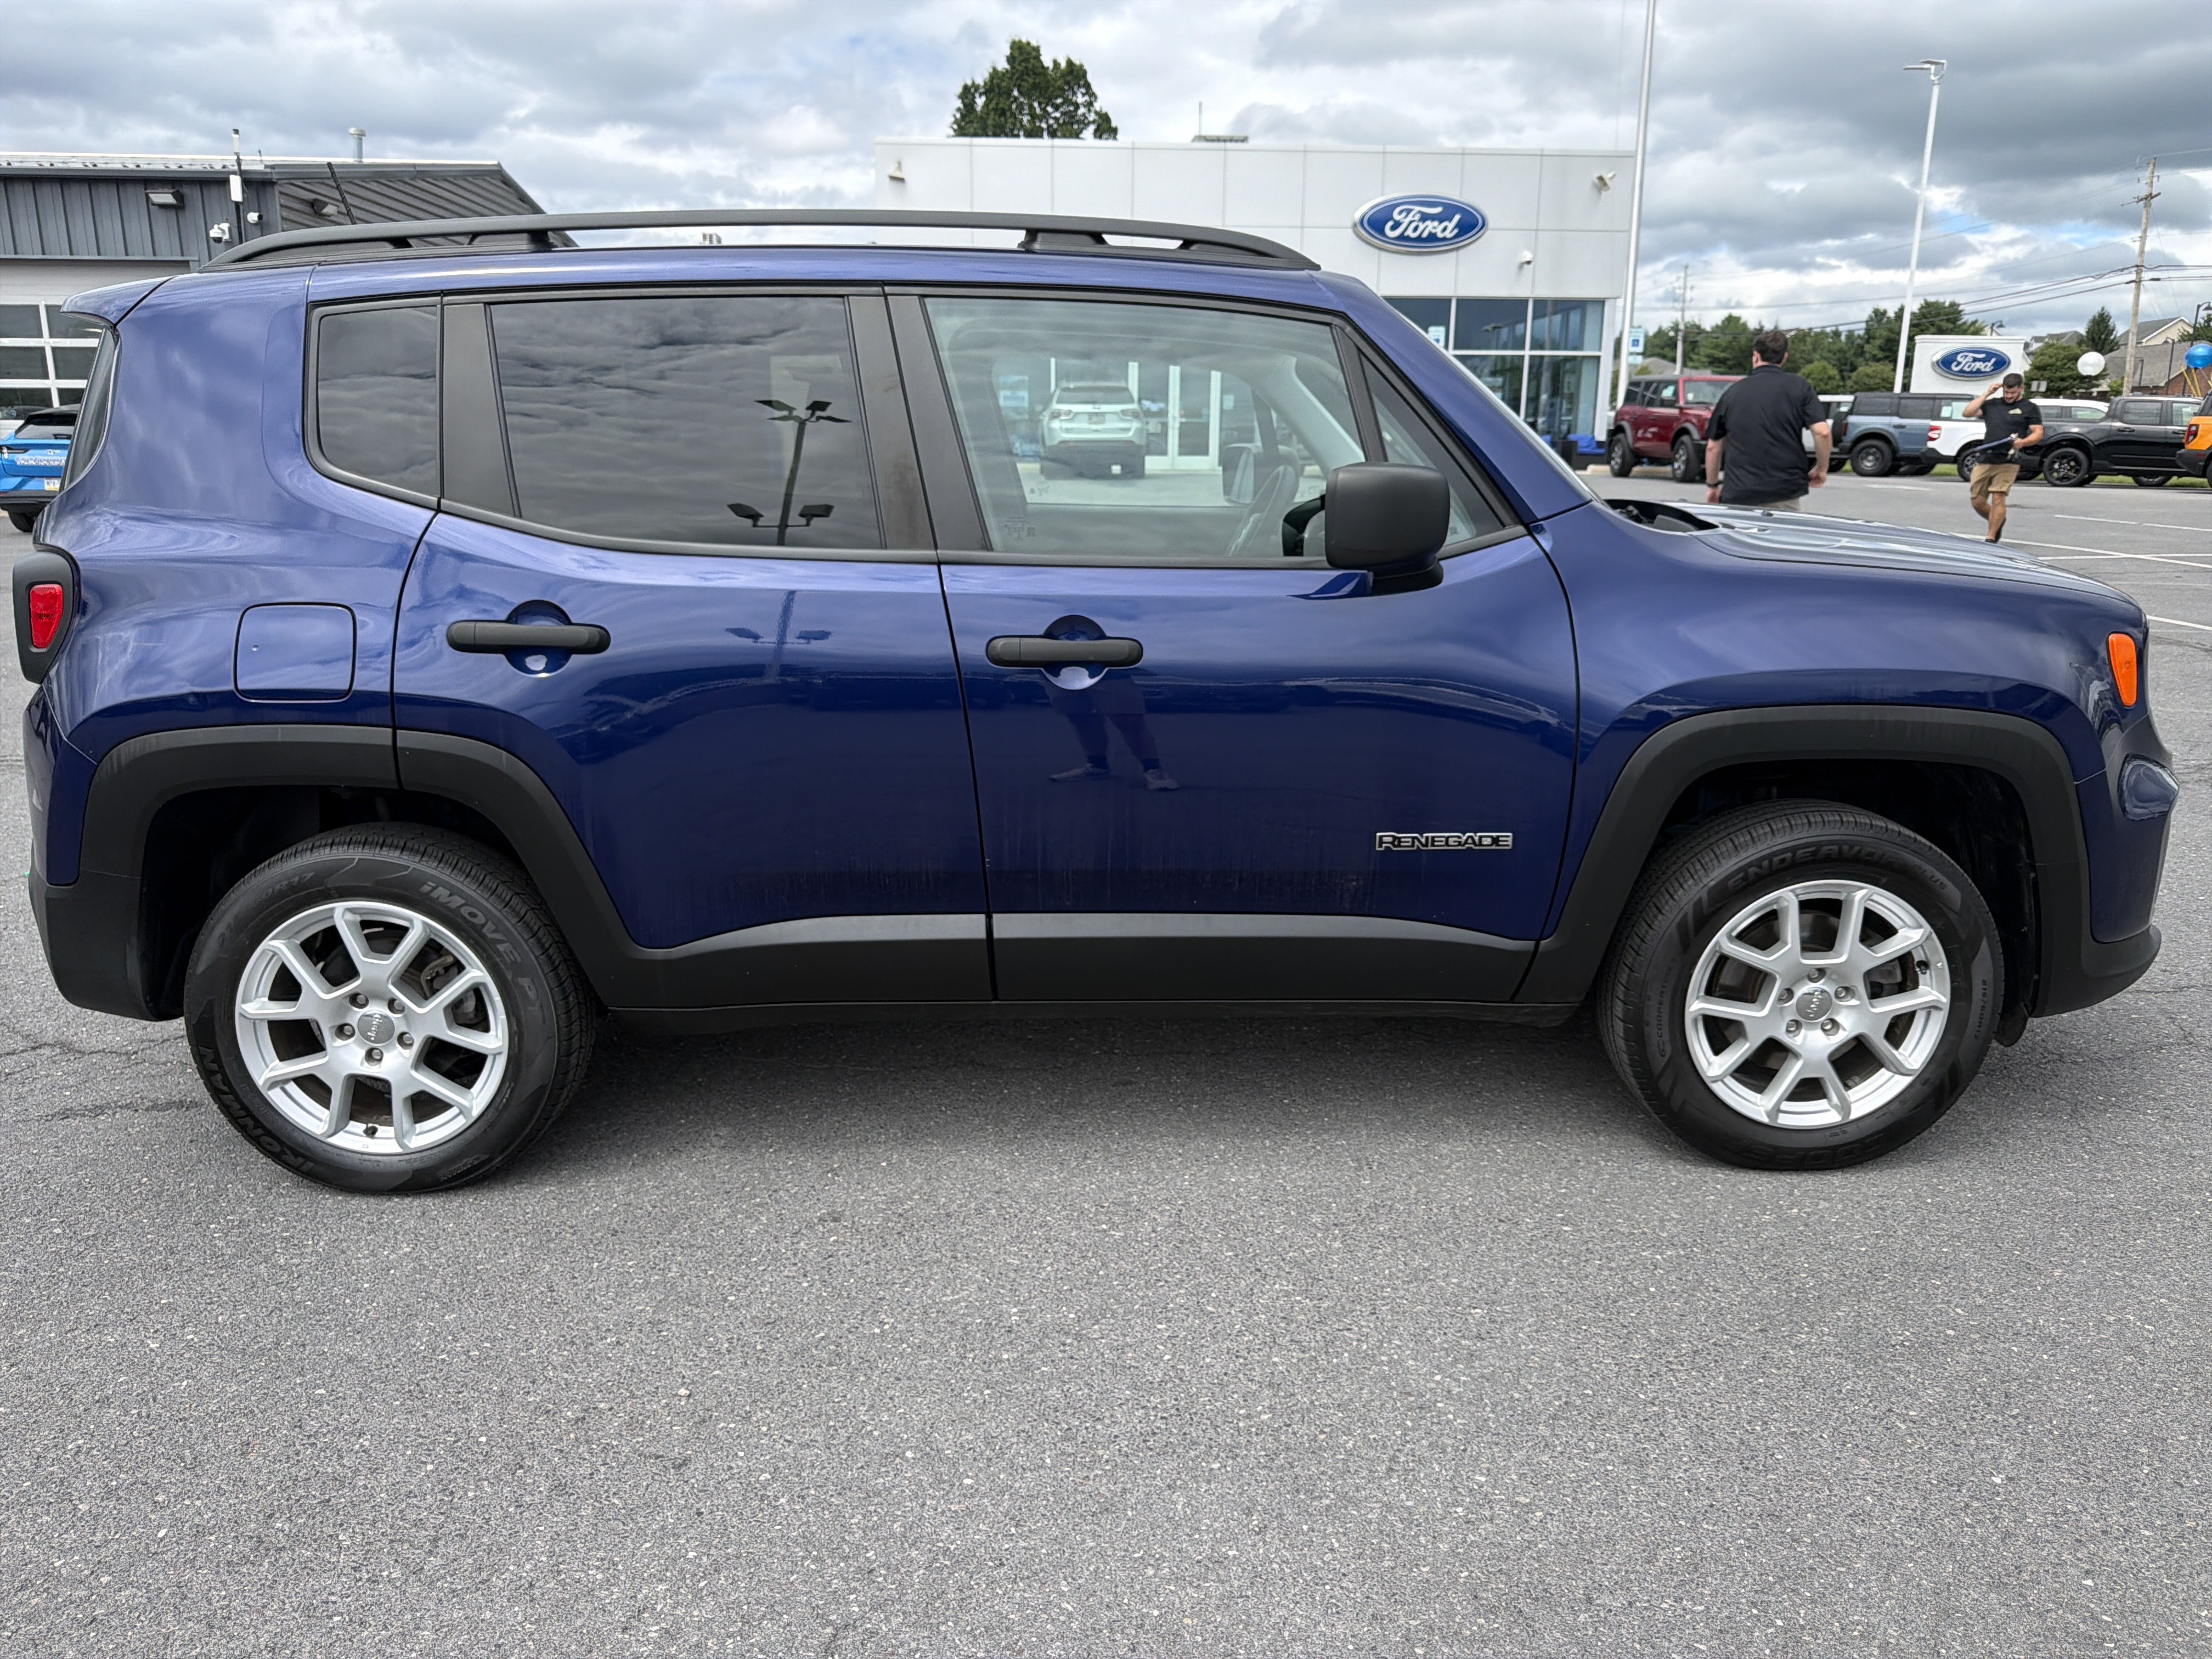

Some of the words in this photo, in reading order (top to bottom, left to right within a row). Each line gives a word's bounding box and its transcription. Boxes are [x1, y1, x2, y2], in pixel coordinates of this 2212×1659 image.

[1384, 205, 1463, 239] Ford
[1951, 352, 1997, 372] Ford
[1376, 832, 1513, 850] RENEGADE
[1728, 844, 1903, 891] ENDEAVOR
[419, 881, 523, 963] iMOVE
[1805, 991, 1825, 1018] Jeep
[367, 1014, 383, 1041] Jeep
[199, 1046, 315, 1173] IRONMAN
